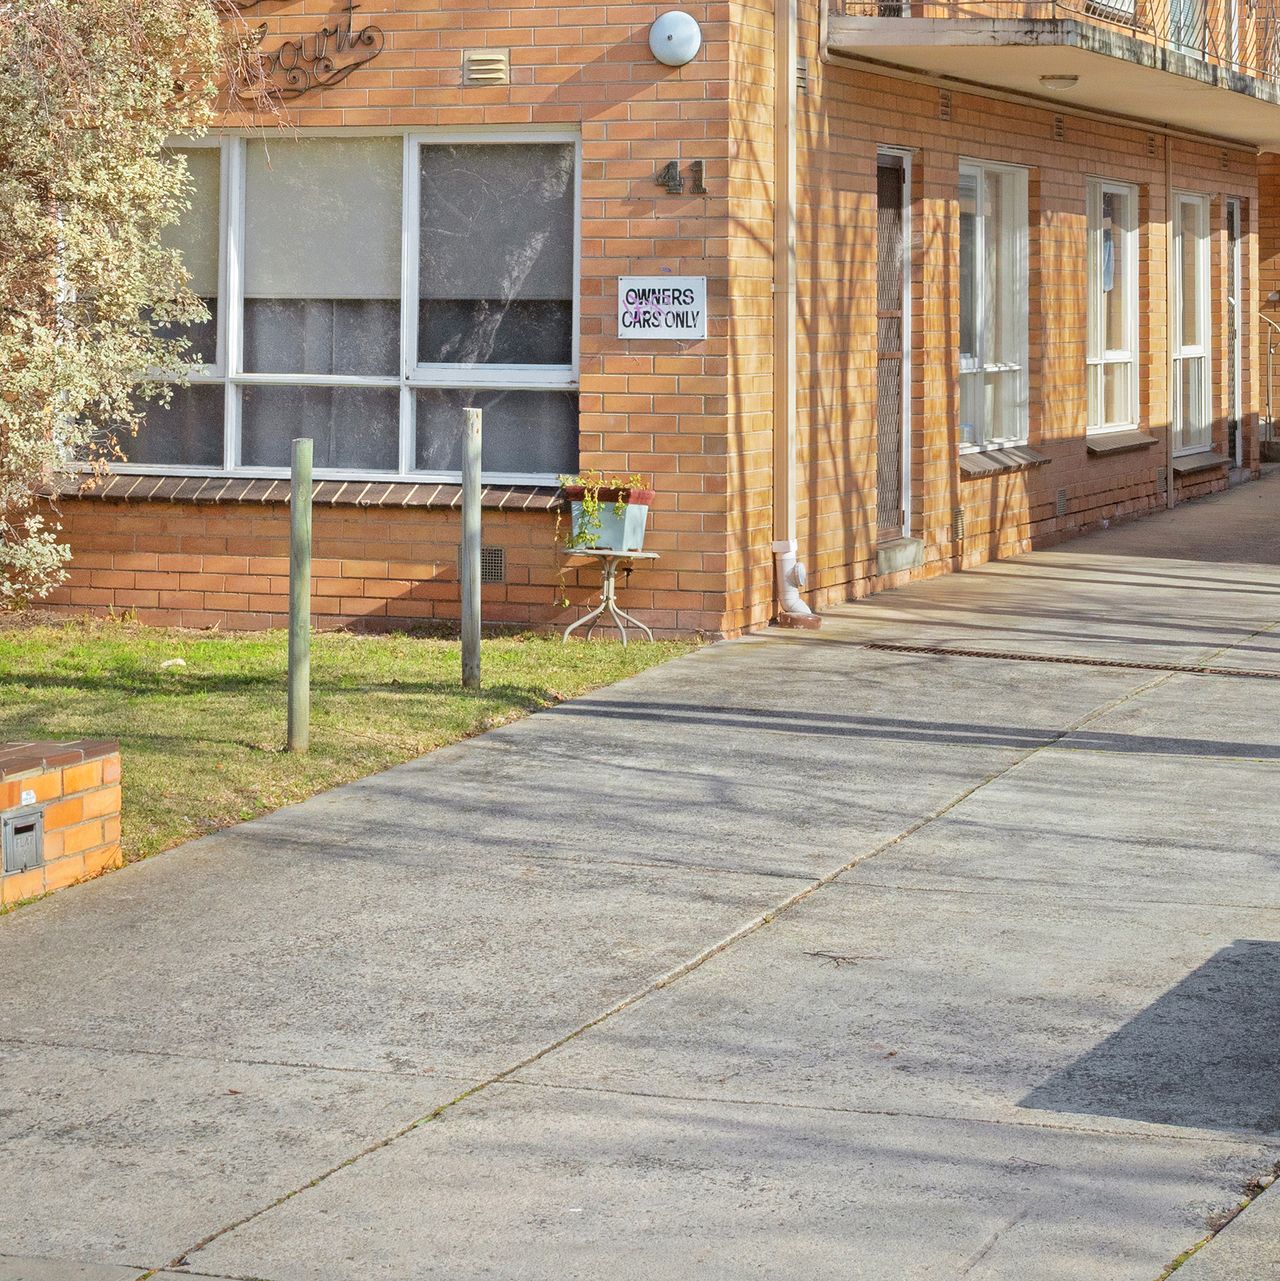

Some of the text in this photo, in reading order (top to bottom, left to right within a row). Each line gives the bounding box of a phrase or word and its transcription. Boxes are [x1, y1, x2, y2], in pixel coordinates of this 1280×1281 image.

[655, 160, 708, 194] 41
[625, 288, 695, 306] OWNERS
[622, 310, 700, 329] CARS ONLY
